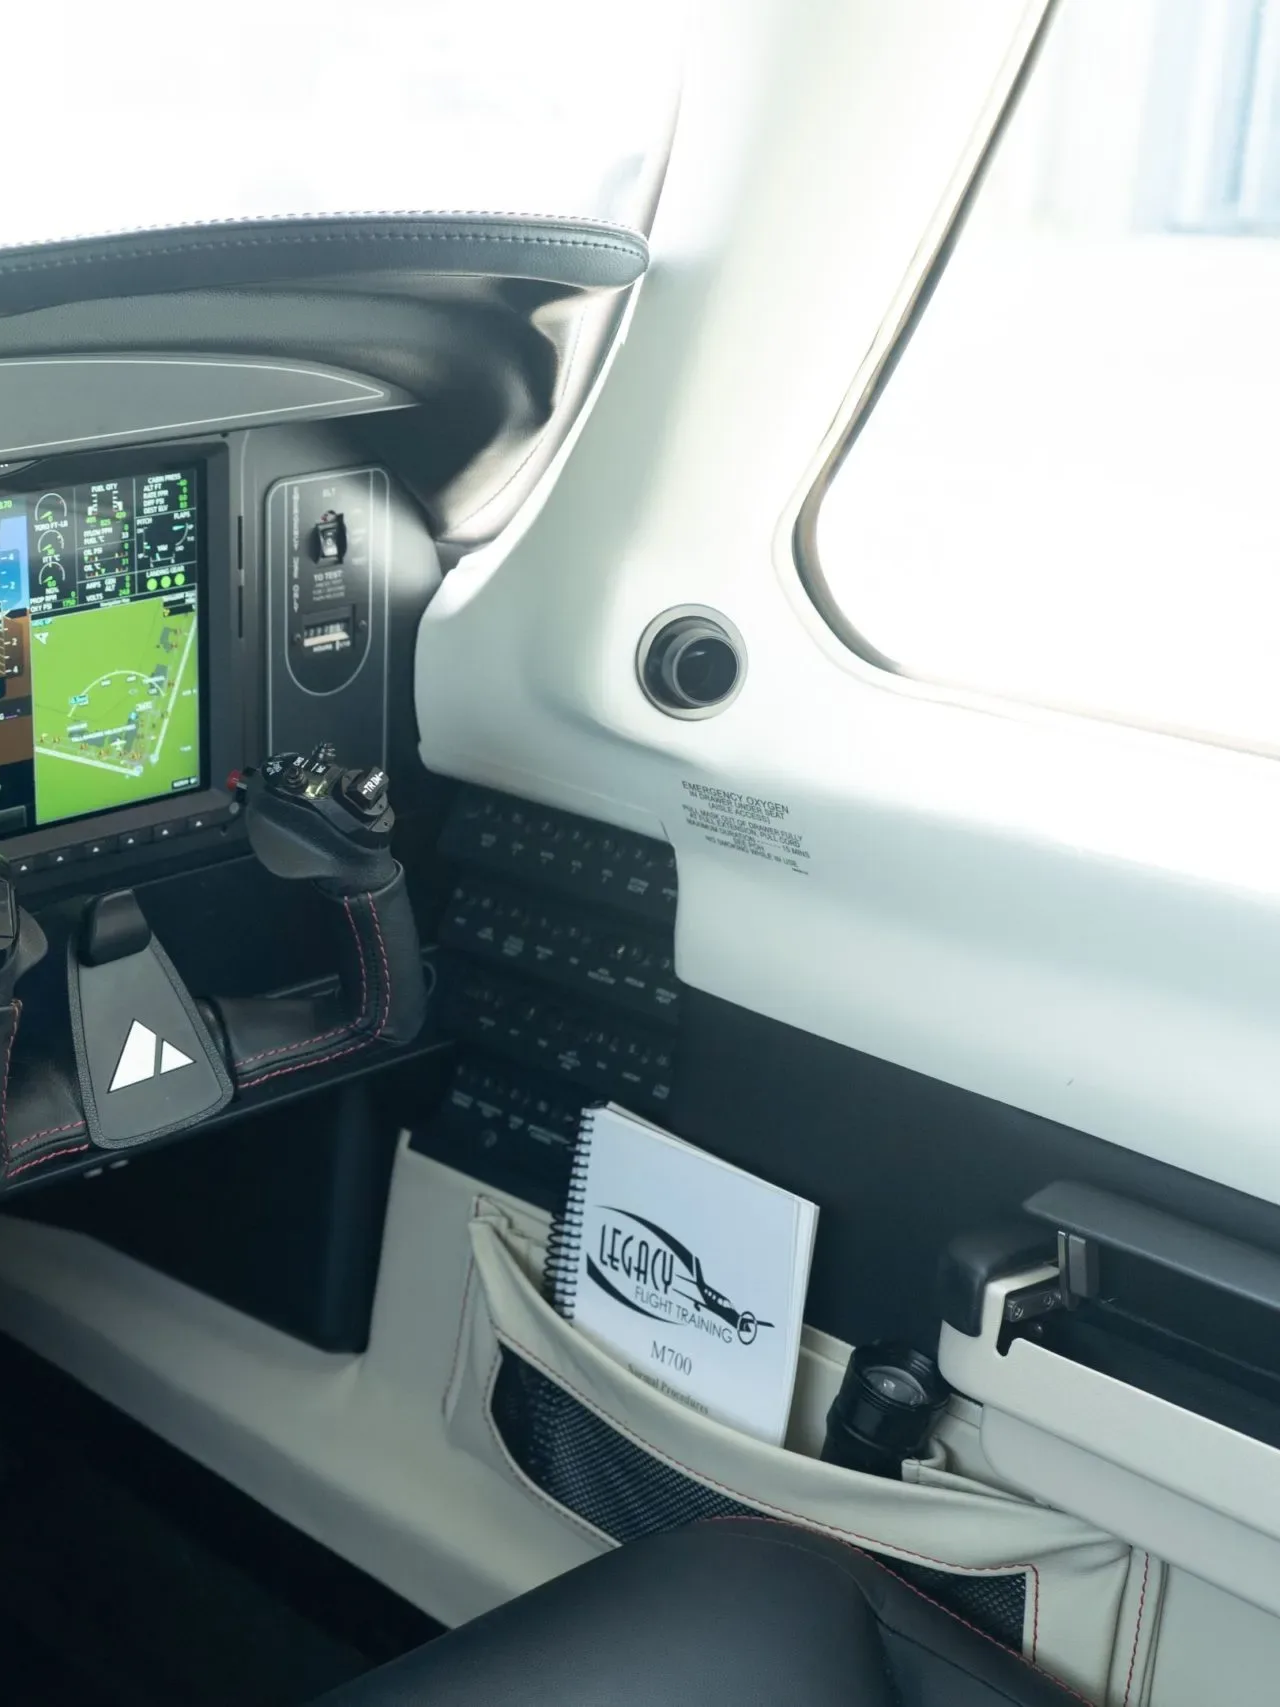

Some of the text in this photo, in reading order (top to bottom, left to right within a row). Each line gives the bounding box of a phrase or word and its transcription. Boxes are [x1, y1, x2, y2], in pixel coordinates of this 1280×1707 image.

[143, 483, 154, 492] ALT
[136, 517, 152, 526] PITCH
[314, 570, 343, 582] TO TEST
[86, 593, 103, 602] VOLTS
[682, 780, 789, 814] EMERGENCY OXYGEN
[699, 793, 785, 820] DRAWER UNDER SEAT
[599, 1223, 674, 1296] LEGACY
[634, 1287, 733, 1344] FLIGHT TRAINING
[651, 1339, 693, 1377] M700
[627, 1361, 709, 1415] Normal Procedures
